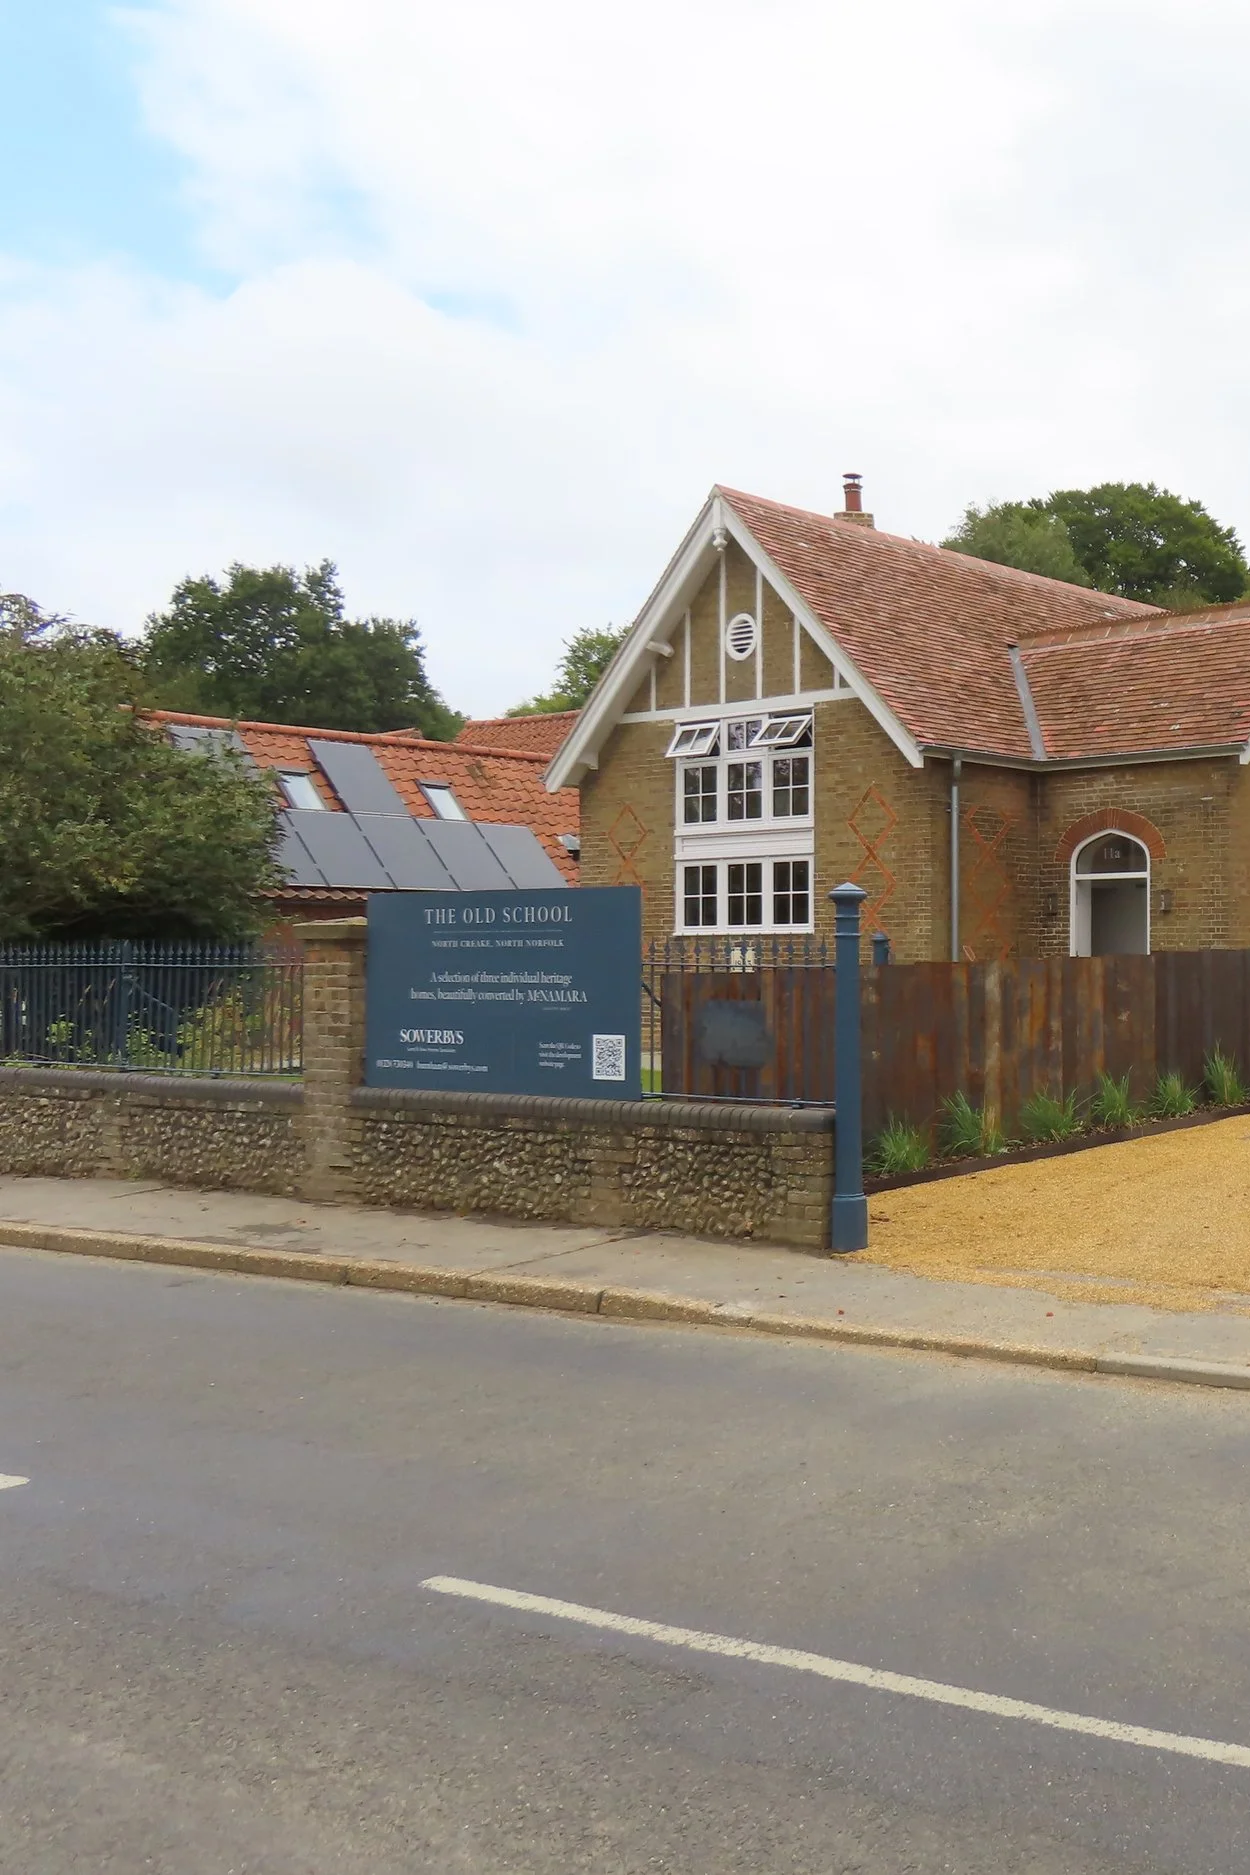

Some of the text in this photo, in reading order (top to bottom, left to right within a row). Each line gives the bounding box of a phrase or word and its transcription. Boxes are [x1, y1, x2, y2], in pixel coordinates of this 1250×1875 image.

[424, 905, 573, 924] THE OLD SCHOOL
[432, 940, 458, 948] NORTH
[526, 939, 564, 947] NORFOLK
[430, 971, 573, 987] A selection of three individual heritage
[437, 988, 476, 1004] beautifully
[478, 989, 514, 1001] converted
[516, 989, 525, 1004] by
[400, 1028, 464, 1045] SOWERBYS
